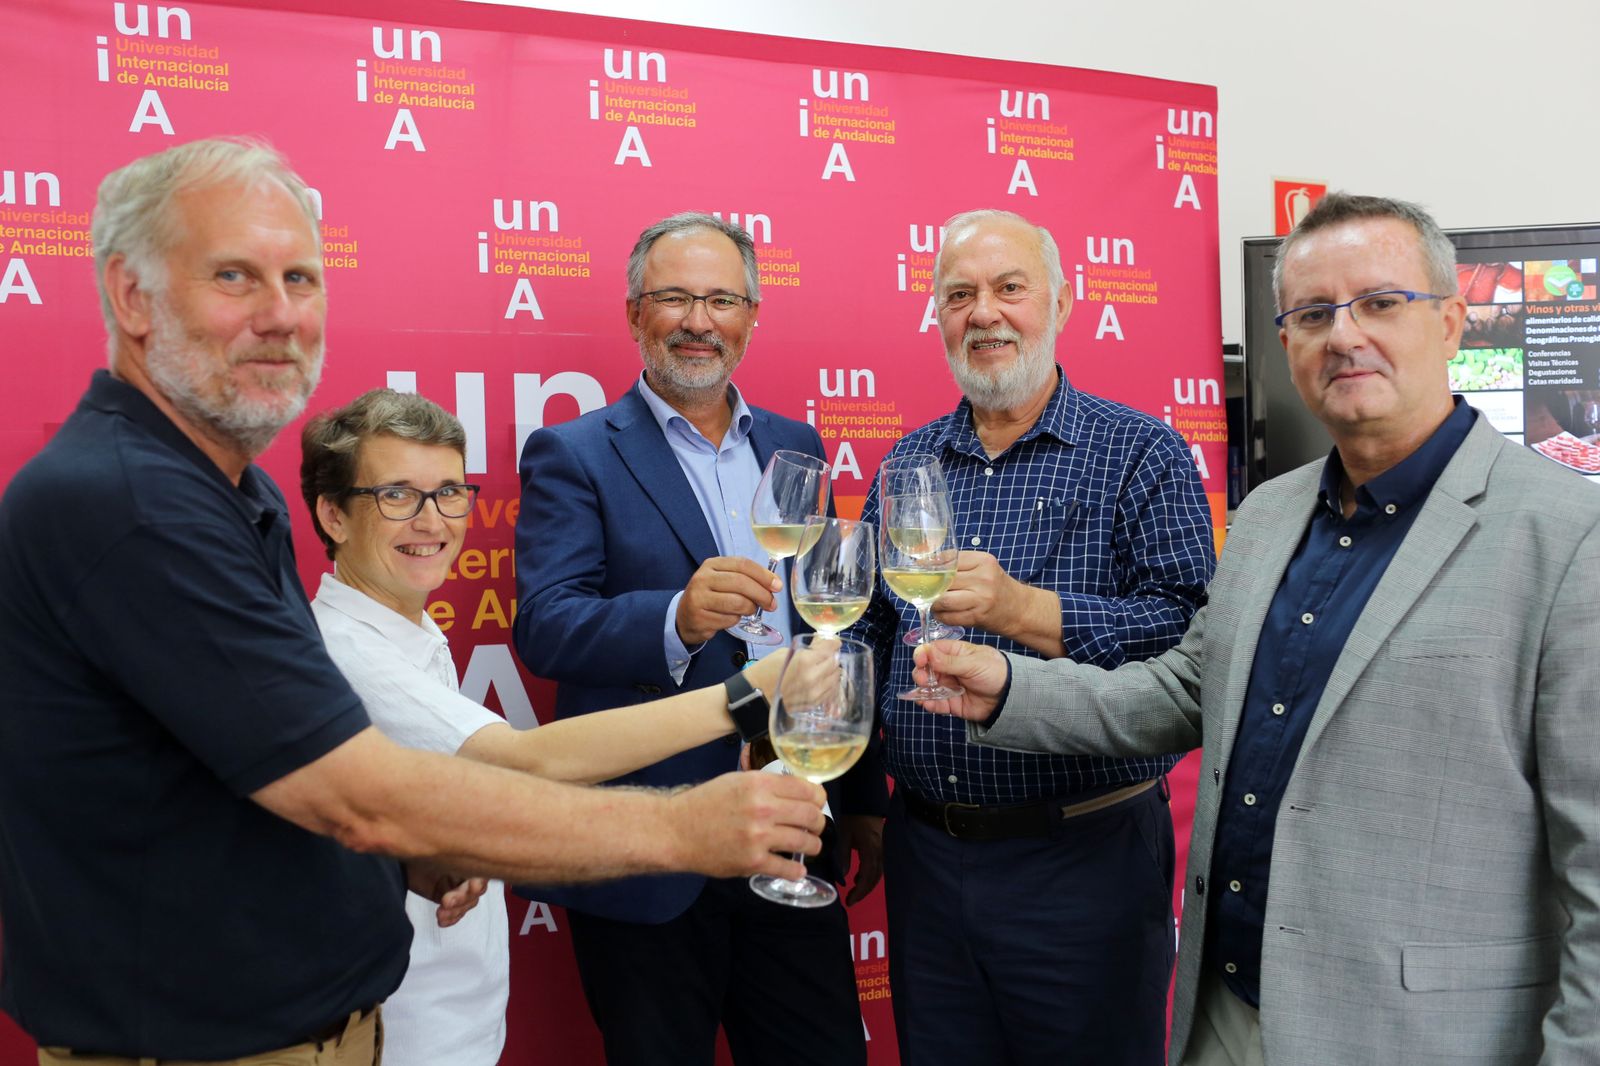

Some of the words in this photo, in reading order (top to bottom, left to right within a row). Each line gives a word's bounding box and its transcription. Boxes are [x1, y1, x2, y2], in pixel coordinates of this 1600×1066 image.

[114, 2, 192, 40] un
[116, 38, 219, 60] Universidad
[372, 26, 442, 62] un
[96, 36, 110, 82] i
[117, 54, 229, 76] Internacional
[374, 62, 466, 80] Universidad
[604, 48, 667, 82] un
[118, 71, 138, 85] de
[144, 72, 230, 92] Andalucía
[356, 59, 368, 102] i
[374, 76, 475, 96] Internacional
[605, 82, 688, 99] Universidad
[812, 69, 870, 102] un
[129, 90, 175, 135] A
[374, 90, 393, 105] de
[398, 92, 476, 110] Andalucía
[590, 80, 600, 120] i
[605, 96, 696, 114] Internacional
[814, 100, 888, 118] Universidad
[1000, 89, 1050, 120] un
[384, 108, 426, 152] A
[605, 109, 623, 122] de
[627, 110, 696, 128] Andalucía
[799, 98, 808, 137] i
[814, 114, 896, 131] Internacional
[1000, 119, 1068, 136] Universidad
[1168, 108, 1212, 138] un
[614, 126, 652, 167] A
[814, 126, 830, 140] de
[833, 128, 896, 144] Andalucía
[986, 118, 996, 154] i
[1000, 132, 1074, 148] Internacional
[822, 143, 856, 182] A
[1000, 144, 1014, 156] de
[1018, 145, 1074, 160] Andalucía
[1156, 134, 1164, 170] i
[1007, 159, 1038, 196] A
[1168, 160, 1180, 171] de
[1174, 174, 1202, 210] A
[494, 198, 559, 232] un
[478, 232, 488, 274] i
[495, 233, 582, 249] Universidad
[1086, 236, 1135, 265] un
[495, 248, 590, 263] Internacional
[0, 258, 42, 304] A
[495, 262, 513, 274] de
[518, 262, 590, 278] Andalucía
[898, 254, 906, 291] i
[1076, 265, 1084, 300] i
[1088, 266, 1152, 280] Universidad
[1088, 279, 1158, 292] Internacional
[1088, 292, 1102, 302] de
[1104, 292, 1158, 304] Andalucía
[504, 278, 544, 320] A
[1526, 305, 1554, 314] Vinos
[1556, 306, 1562, 314] y
[1564, 304, 1590, 313] otras
[1096, 304, 1124, 341] A
[1526, 317, 1572, 325] alimentarios
[1526, 326, 1586, 334] Denominaciones
[1526, 336, 1568, 345] Geográficas
[820, 368, 876, 398] un
[1528, 369, 1576, 377] Degustaciones
[1174, 378, 1220, 406] un
[820, 400, 896, 412] Universidad
[821, 414, 902, 426] Internacional
[821, 427, 836, 439] de
[840, 427, 903, 439] Andalucía
[830, 442, 864, 480] A
[520, 900, 558, 936] A
